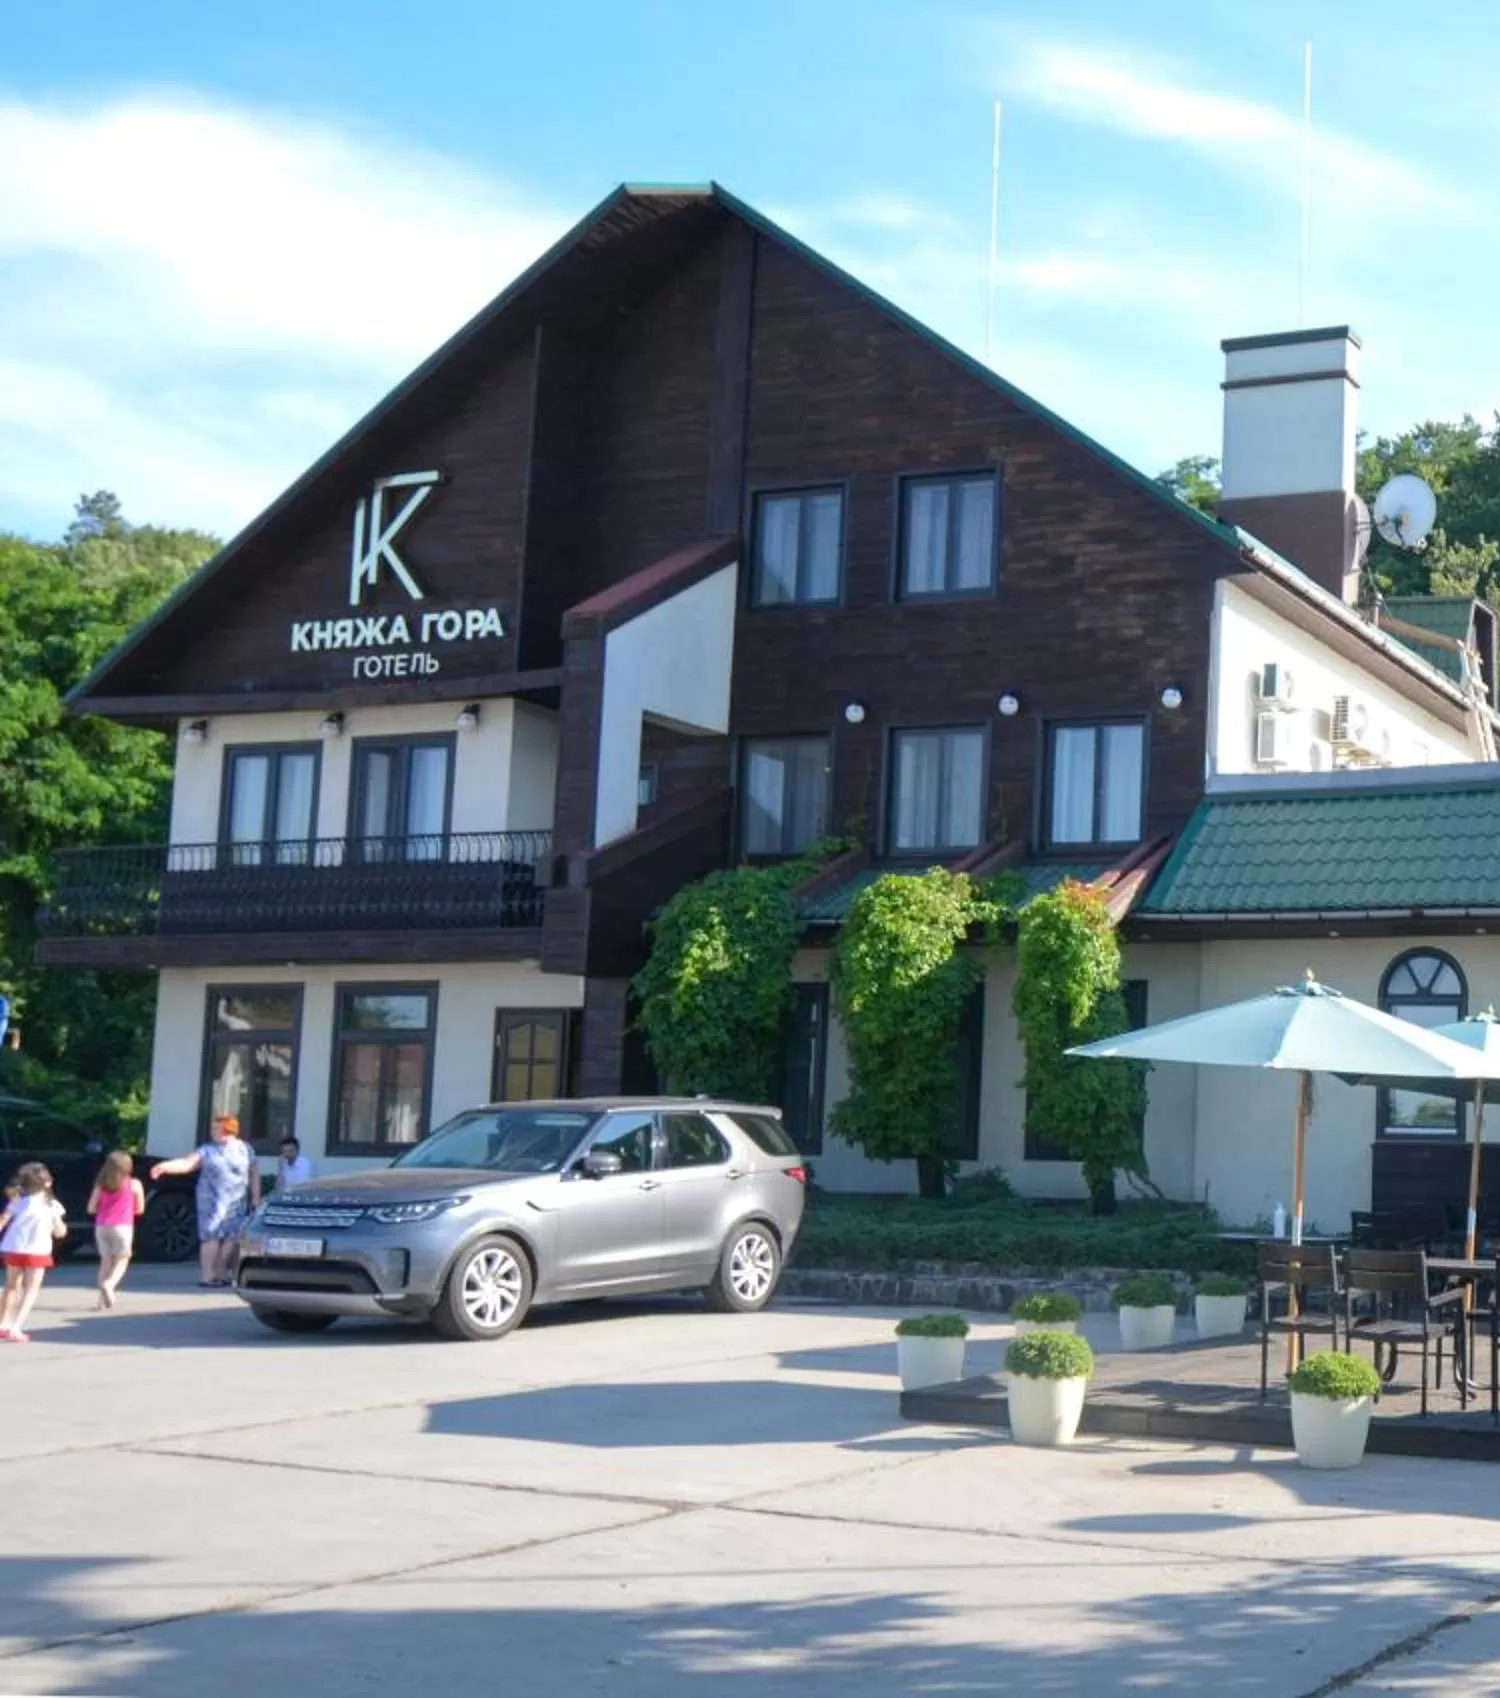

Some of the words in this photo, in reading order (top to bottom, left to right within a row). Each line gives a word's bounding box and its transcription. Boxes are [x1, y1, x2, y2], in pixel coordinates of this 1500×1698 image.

[290, 615, 411, 651] КНЯЖА
[421, 608, 504, 643] ГОРА
[353, 652, 440, 678] ГОТЕЛЬ
